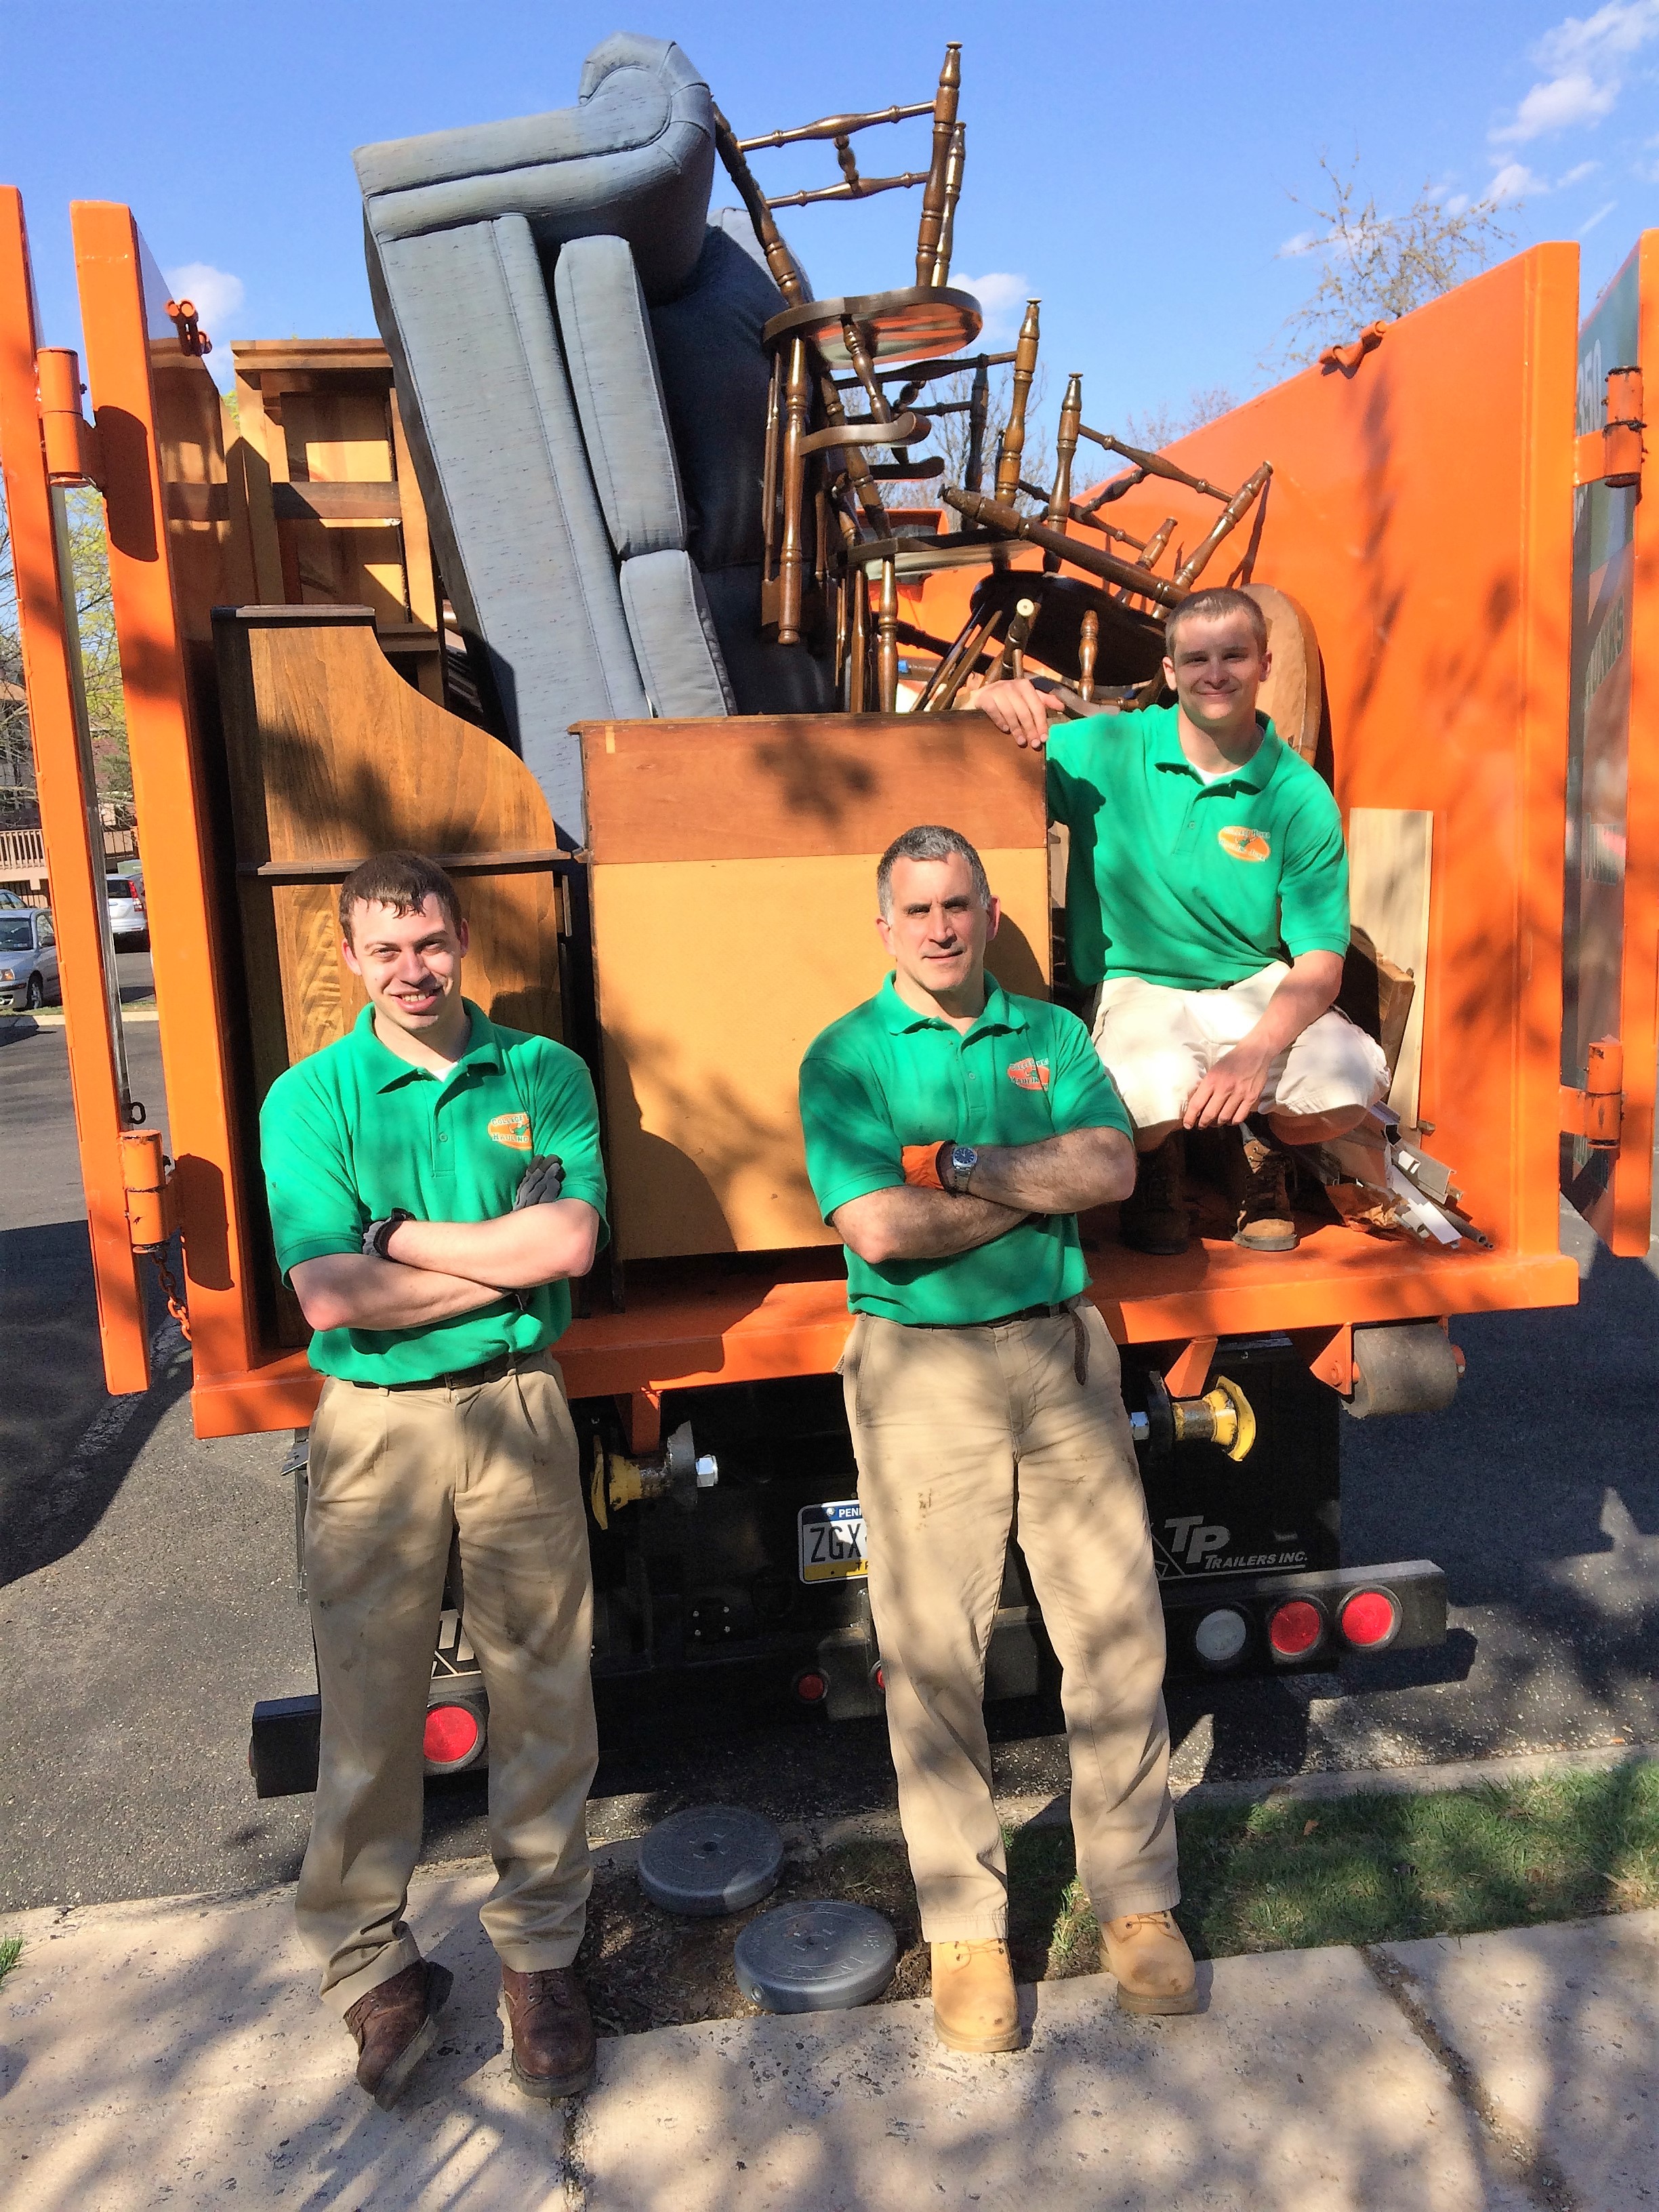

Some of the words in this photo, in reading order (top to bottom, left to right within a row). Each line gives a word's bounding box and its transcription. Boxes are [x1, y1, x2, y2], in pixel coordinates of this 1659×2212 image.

[809, 1523, 867, 1563] ZGX
[1164, 1515, 1231, 1564] TP
[1204, 1555, 1275, 1570] TRAILERS
[1278, 1551, 1308, 1564] INC.
